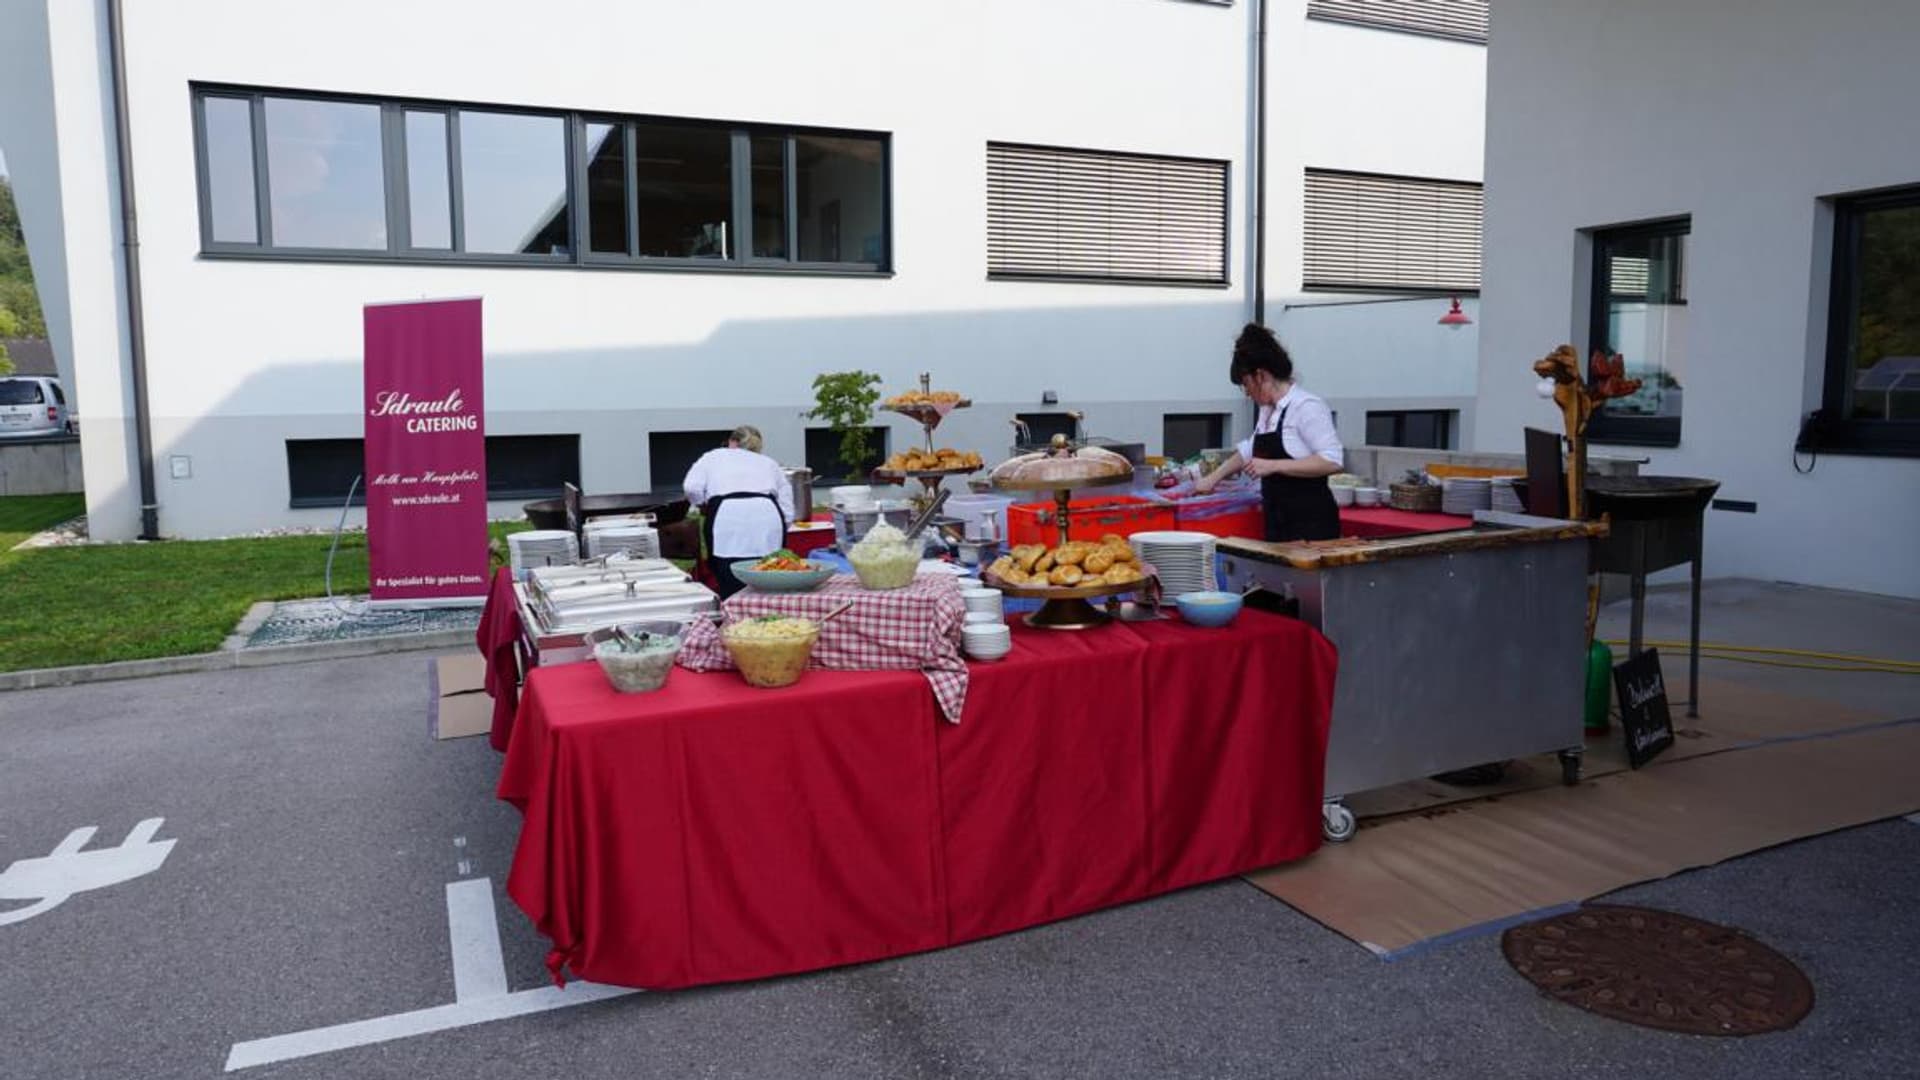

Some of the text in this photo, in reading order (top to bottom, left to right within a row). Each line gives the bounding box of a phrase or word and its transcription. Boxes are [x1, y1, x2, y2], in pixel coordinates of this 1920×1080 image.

[370, 388, 464, 416] Sdraule
[406, 415, 478, 433] CATERING
[421, 470, 479, 485] Hauptplatz
[392, 493, 460, 505] www.sdraule.at
[376, 578, 386, 586] Ihr
[388, 576, 423, 587] Spezialist
[425, 575, 436, 585] für
[437, 576, 458, 586] gutes
